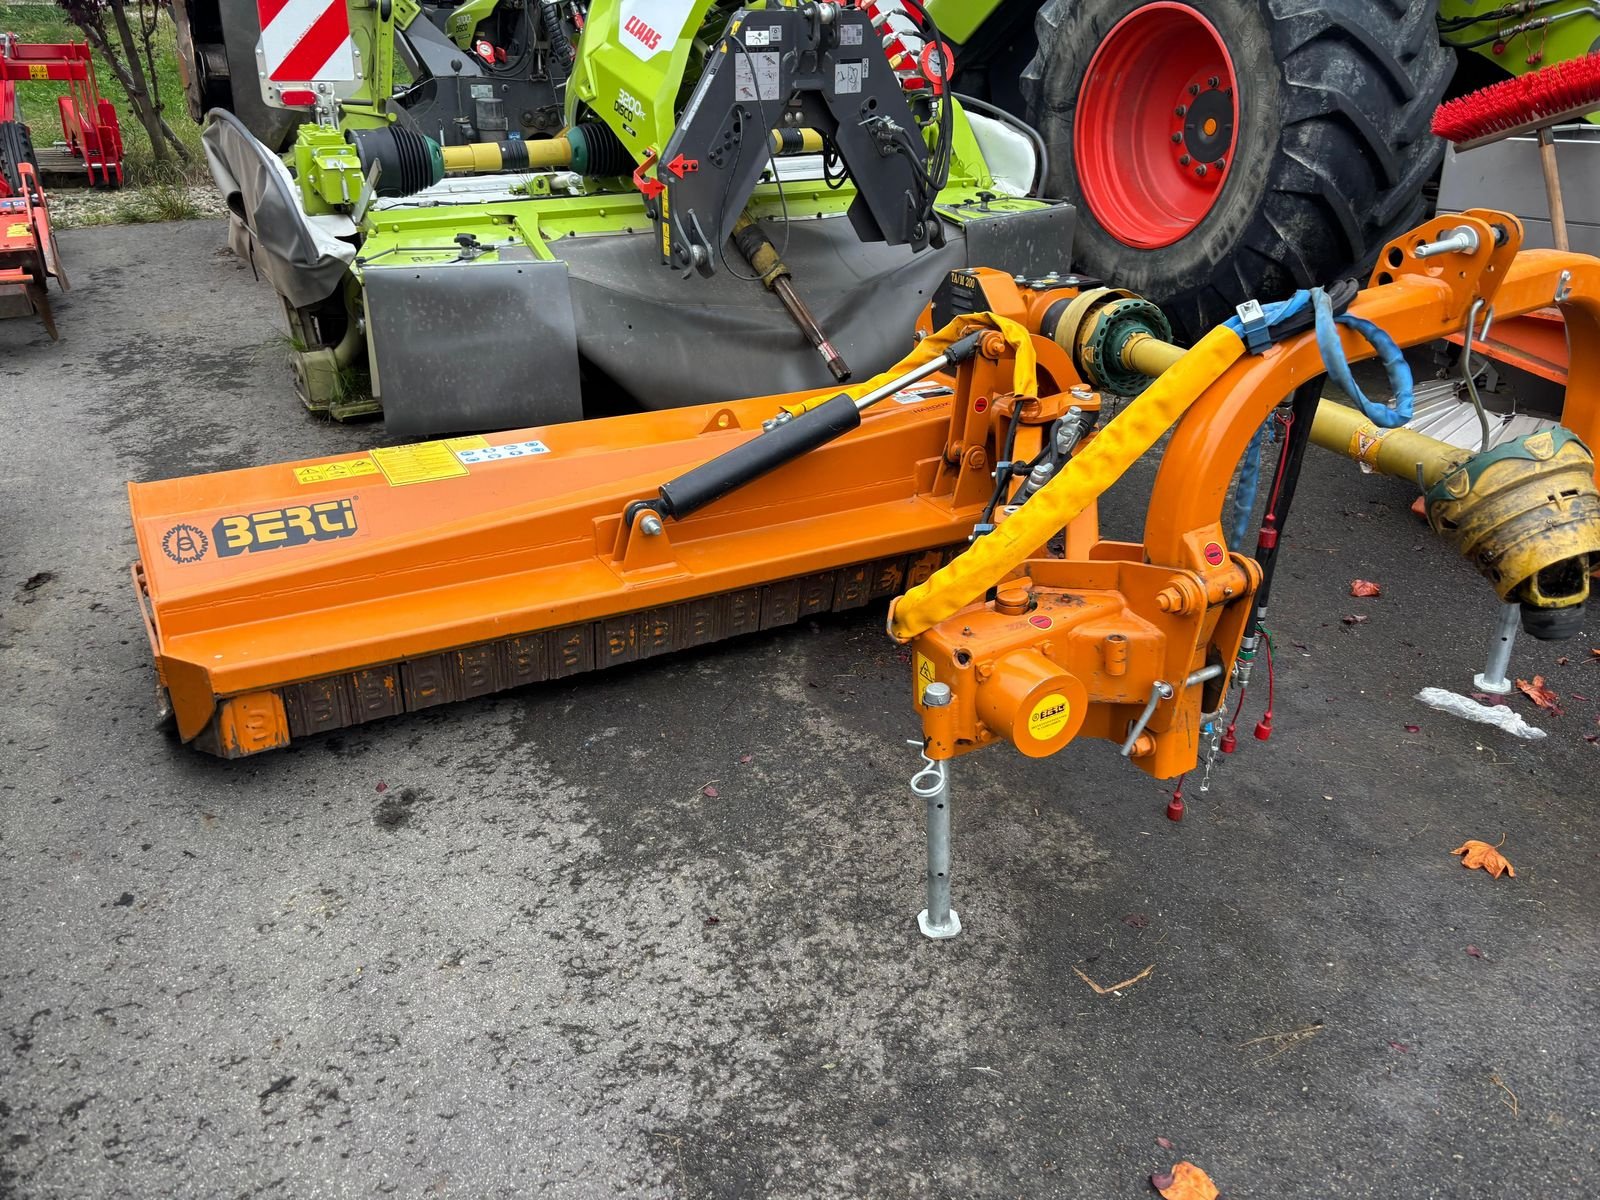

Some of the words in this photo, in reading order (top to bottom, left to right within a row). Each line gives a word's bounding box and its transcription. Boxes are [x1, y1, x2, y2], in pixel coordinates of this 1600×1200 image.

[624, 15, 662, 50] CLAAS
[614, 100, 633, 122] DISCO
[965, 277, 976, 289] 200
[214, 499, 357, 557] BERTI
